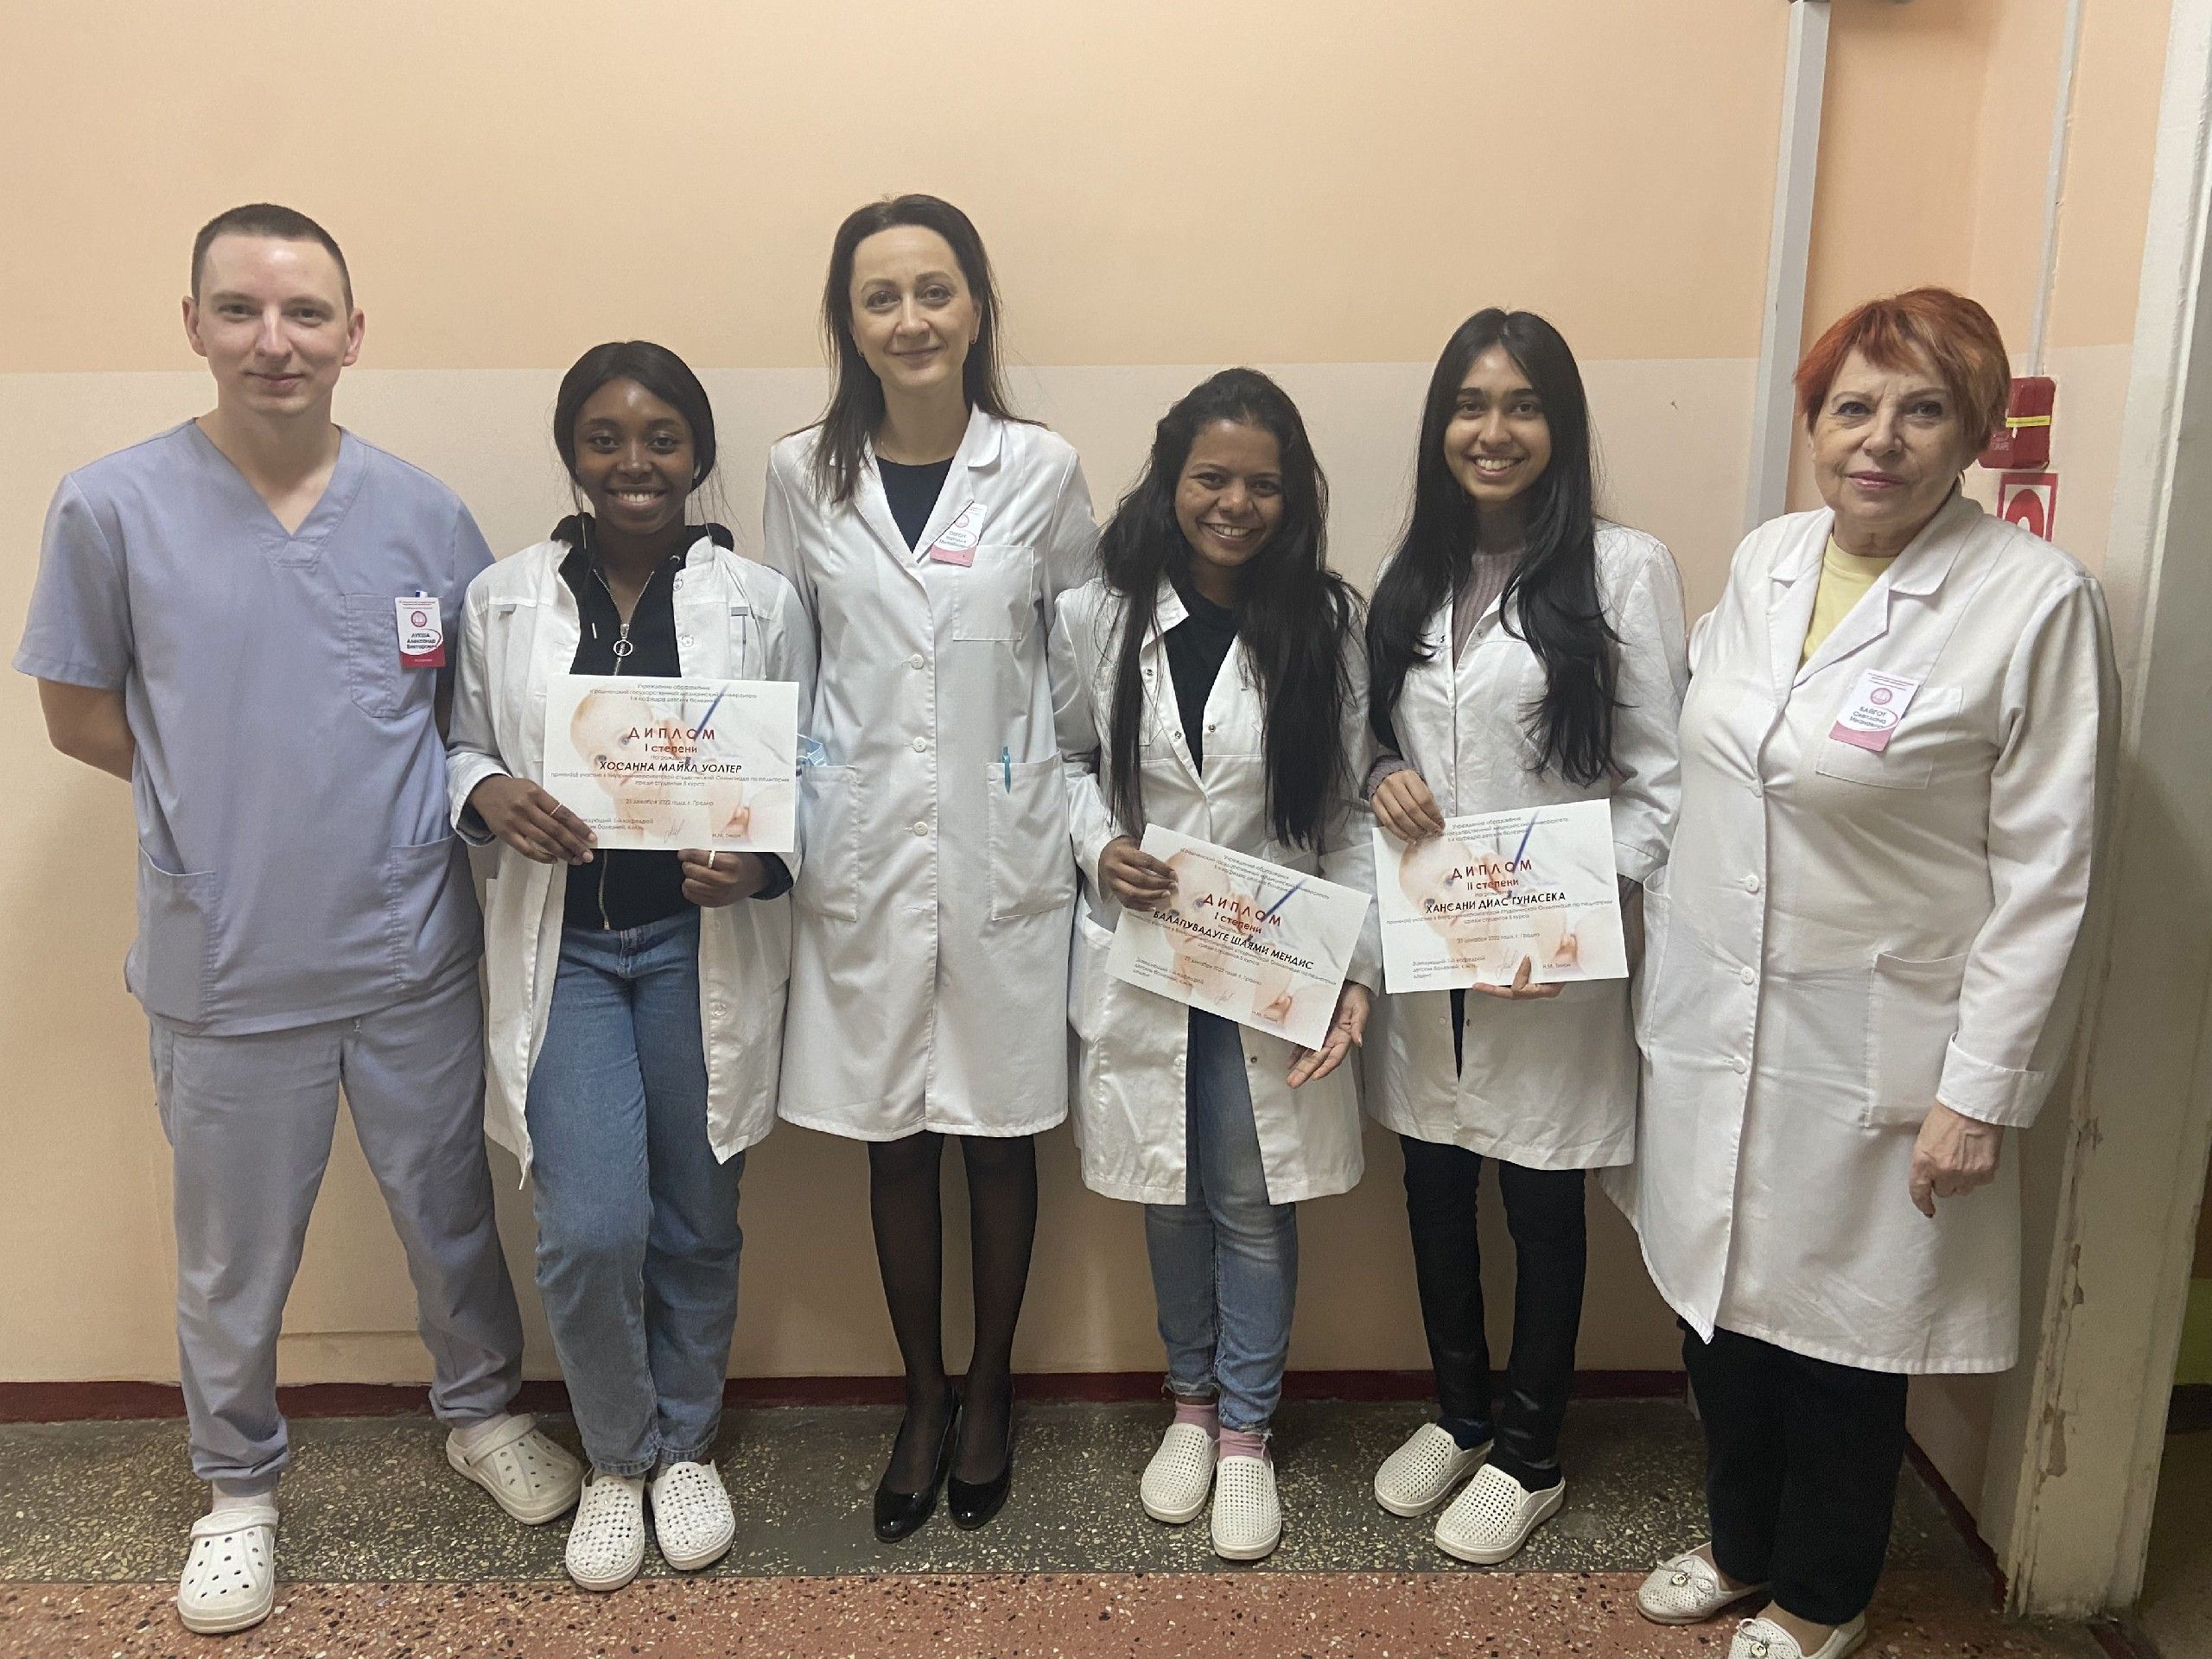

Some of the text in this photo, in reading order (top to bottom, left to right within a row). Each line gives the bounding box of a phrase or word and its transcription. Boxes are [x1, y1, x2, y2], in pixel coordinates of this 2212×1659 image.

[627, 727, 715, 741] ДИПЛОМ
[645, 743, 696, 753] I степени
[600, 760, 741, 774] ХОСАННА МАЙКЛ УОЛТЕР
[1451, 859, 1532, 880] ДИПЛОМ
[1475, 878, 1519, 889] степени
[1203, 893, 1281, 927] ДИПЛОМ
[1424, 900, 1476, 914] ХАНСАНИ
[1478, 897, 1509, 909] ДИАС
[1511, 891, 1566, 906] ГУНАСЕКА
[1219, 915, 1262, 933] степени
[1153, 910, 1229, 941] БАЛАПУВАДУГЕ
[1230, 936, 1268, 954] ШАЯМИ
[1269, 949, 1314, 969] МЕНДИС
